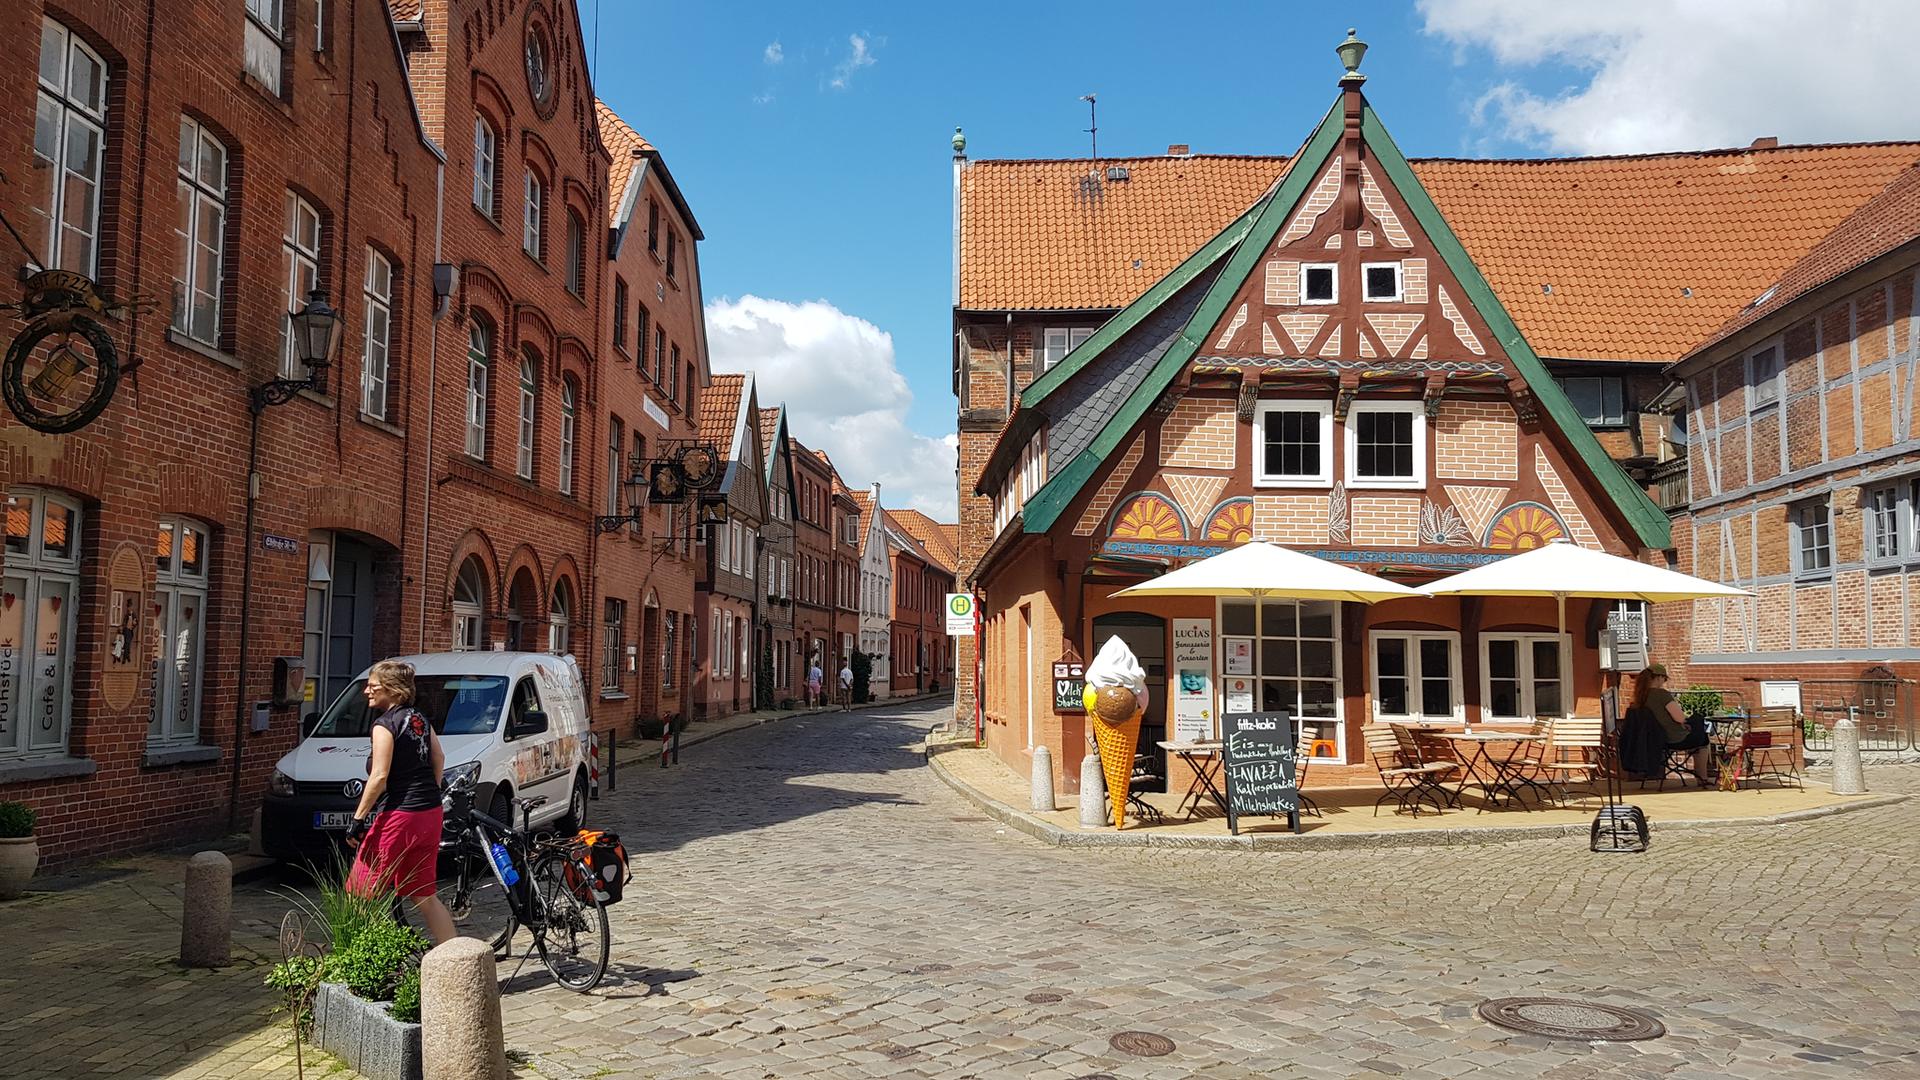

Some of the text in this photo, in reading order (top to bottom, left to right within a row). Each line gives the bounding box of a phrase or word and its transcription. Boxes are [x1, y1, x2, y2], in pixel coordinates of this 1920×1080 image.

[51, 272, 90, 294] 1722
[42, 632, 58, 730] Café & Eis
[1232, 763, 1286, 783] LAVAZZA
[1233, 795, 1295, 812] Milchshakes
